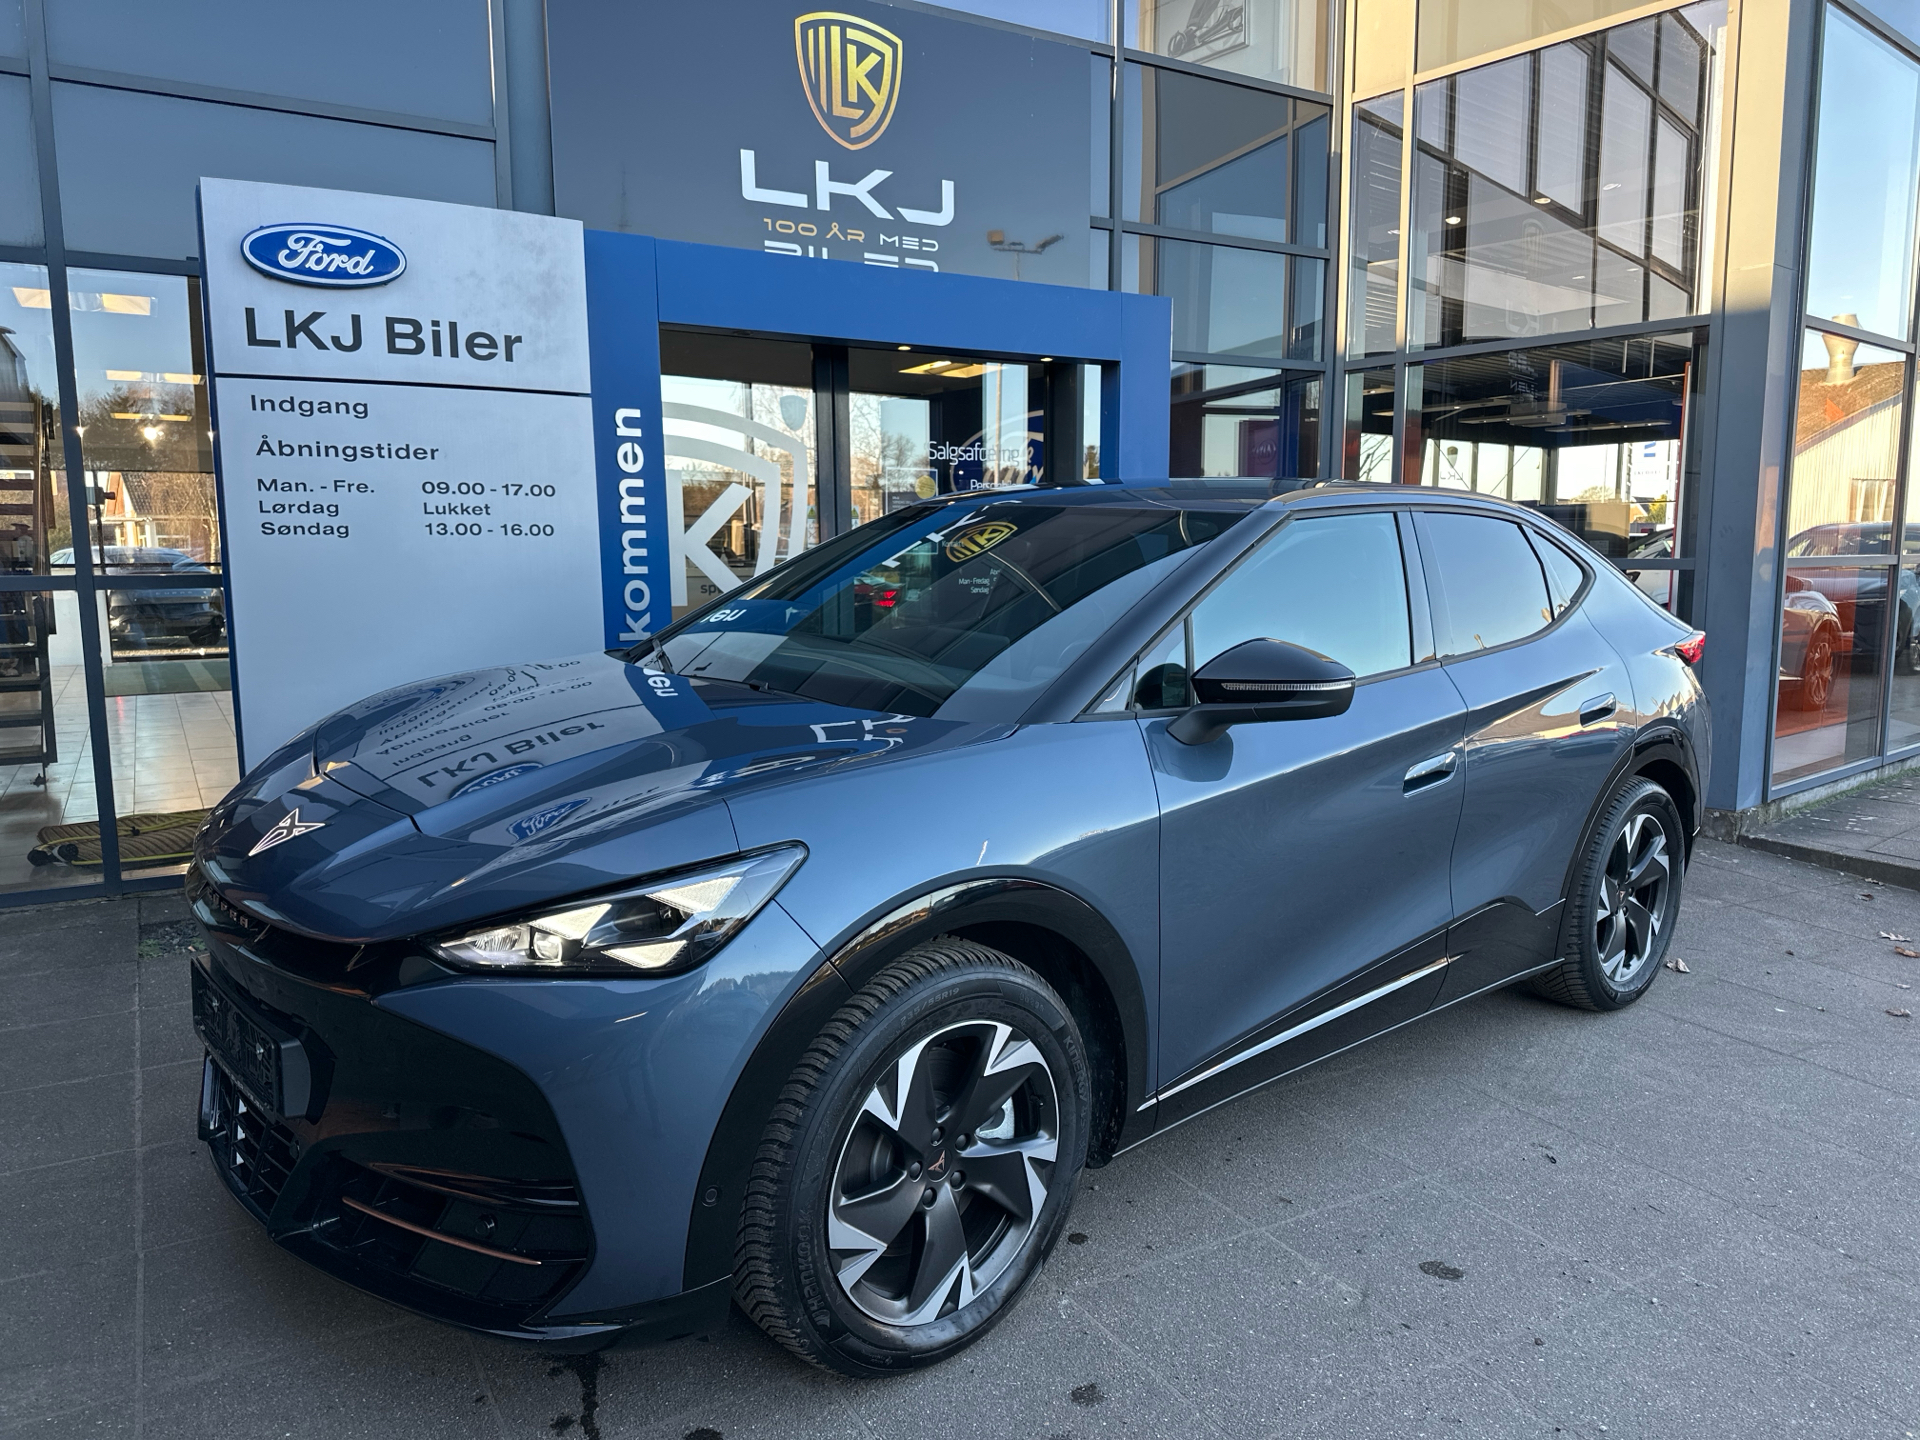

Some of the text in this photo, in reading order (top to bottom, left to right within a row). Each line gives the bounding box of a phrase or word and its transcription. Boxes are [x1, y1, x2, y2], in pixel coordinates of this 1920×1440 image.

[740, 149, 955, 226] LKJ
[763, 218, 939, 252] 100 ÅR MED
[277, 232, 376, 277] Ford
[245, 307, 522, 362] LKJ Biler
[251, 395, 368, 419] Indgang
[256, 435, 439, 462] Åbningstider
[258, 479, 313, 492] Man.
[334, 480, 374, 493] Fre.
[422, 482, 484, 495] 09.00
[502, 484, 555, 497] 17.00
[259, 501, 490, 517] Lørdag Lukket
[261, 522, 349, 538] Søndag
[425, 523, 482, 535] 13.00
[501, 524, 554, 536] 16.00
